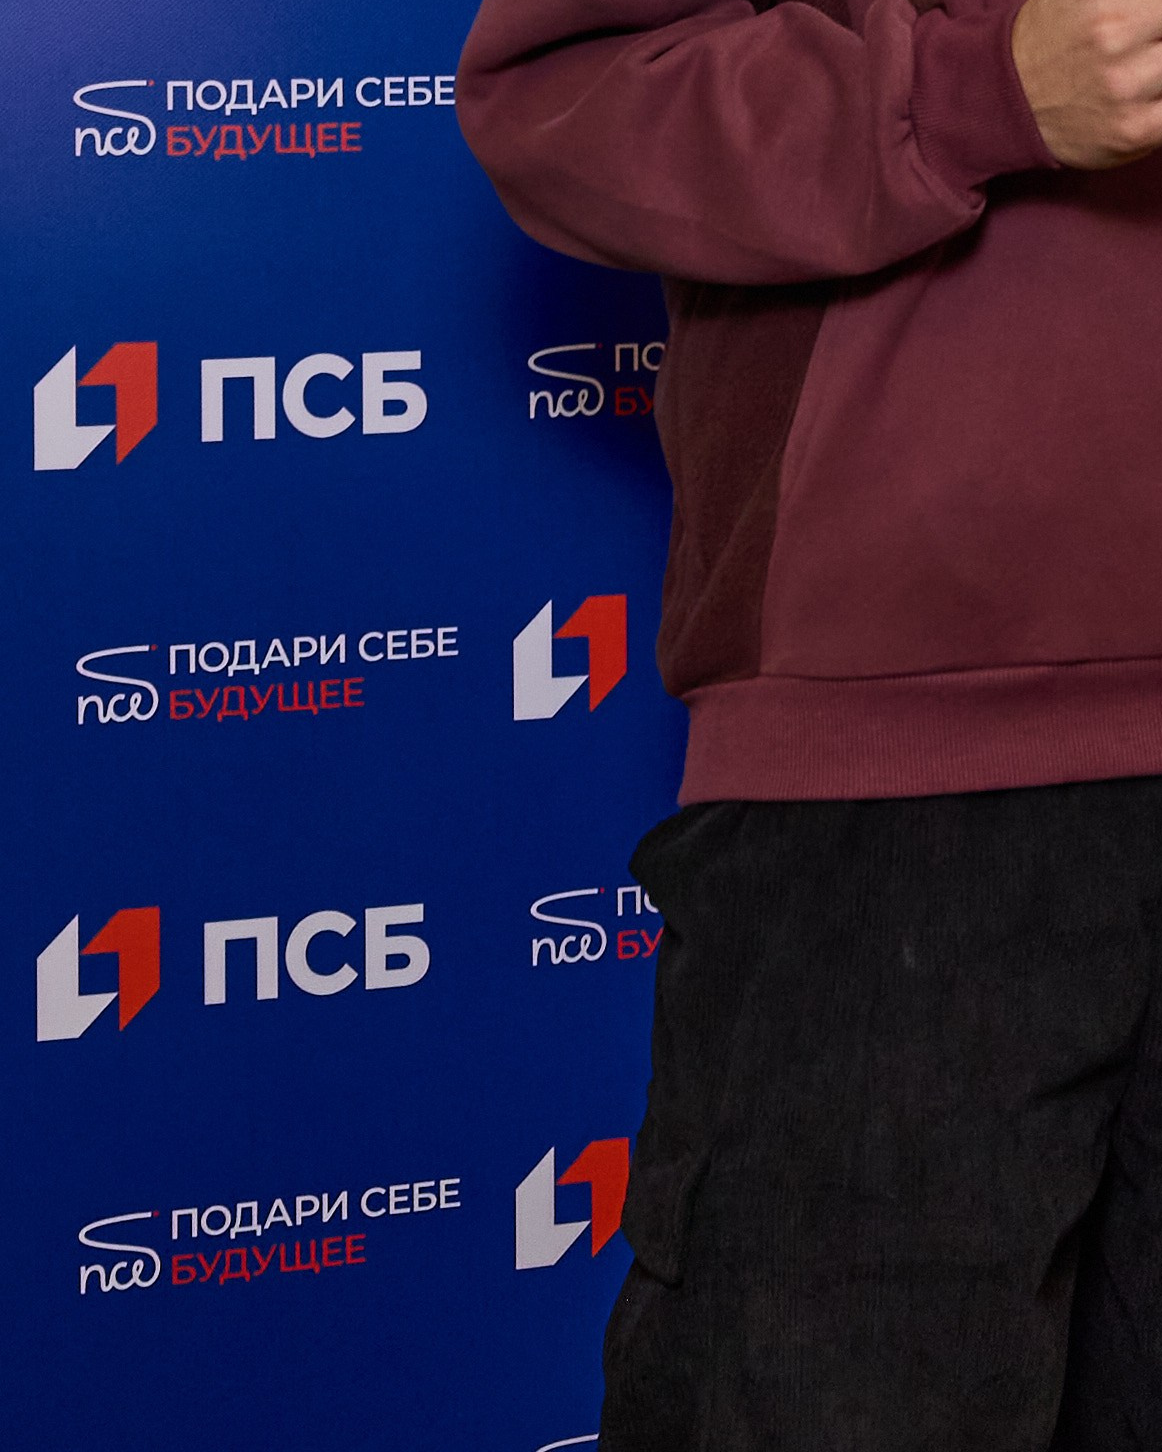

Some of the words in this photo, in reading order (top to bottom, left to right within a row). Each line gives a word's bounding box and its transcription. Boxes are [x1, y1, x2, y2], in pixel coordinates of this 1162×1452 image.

[167, 78, 343, 115] ПОДАРИ
[356, 76, 455, 107] СЕБЕ
[167, 122, 360, 160] БУДУЩЕЕ
[201, 350, 427, 442] ПСБ
[170, 634, 345, 677] ПОДАРИ
[359, 627, 458, 661] СЕБЕ
[170, 678, 364, 721] БУДУЩЕЕ
[204, 903, 430, 1005] ПСБ
[172, 1191, 347, 1239] ПОДАРИ
[361, 1178, 461, 1217] СЕБЕ
[172, 1234, 366, 1284] БУДУЩЕЕ
